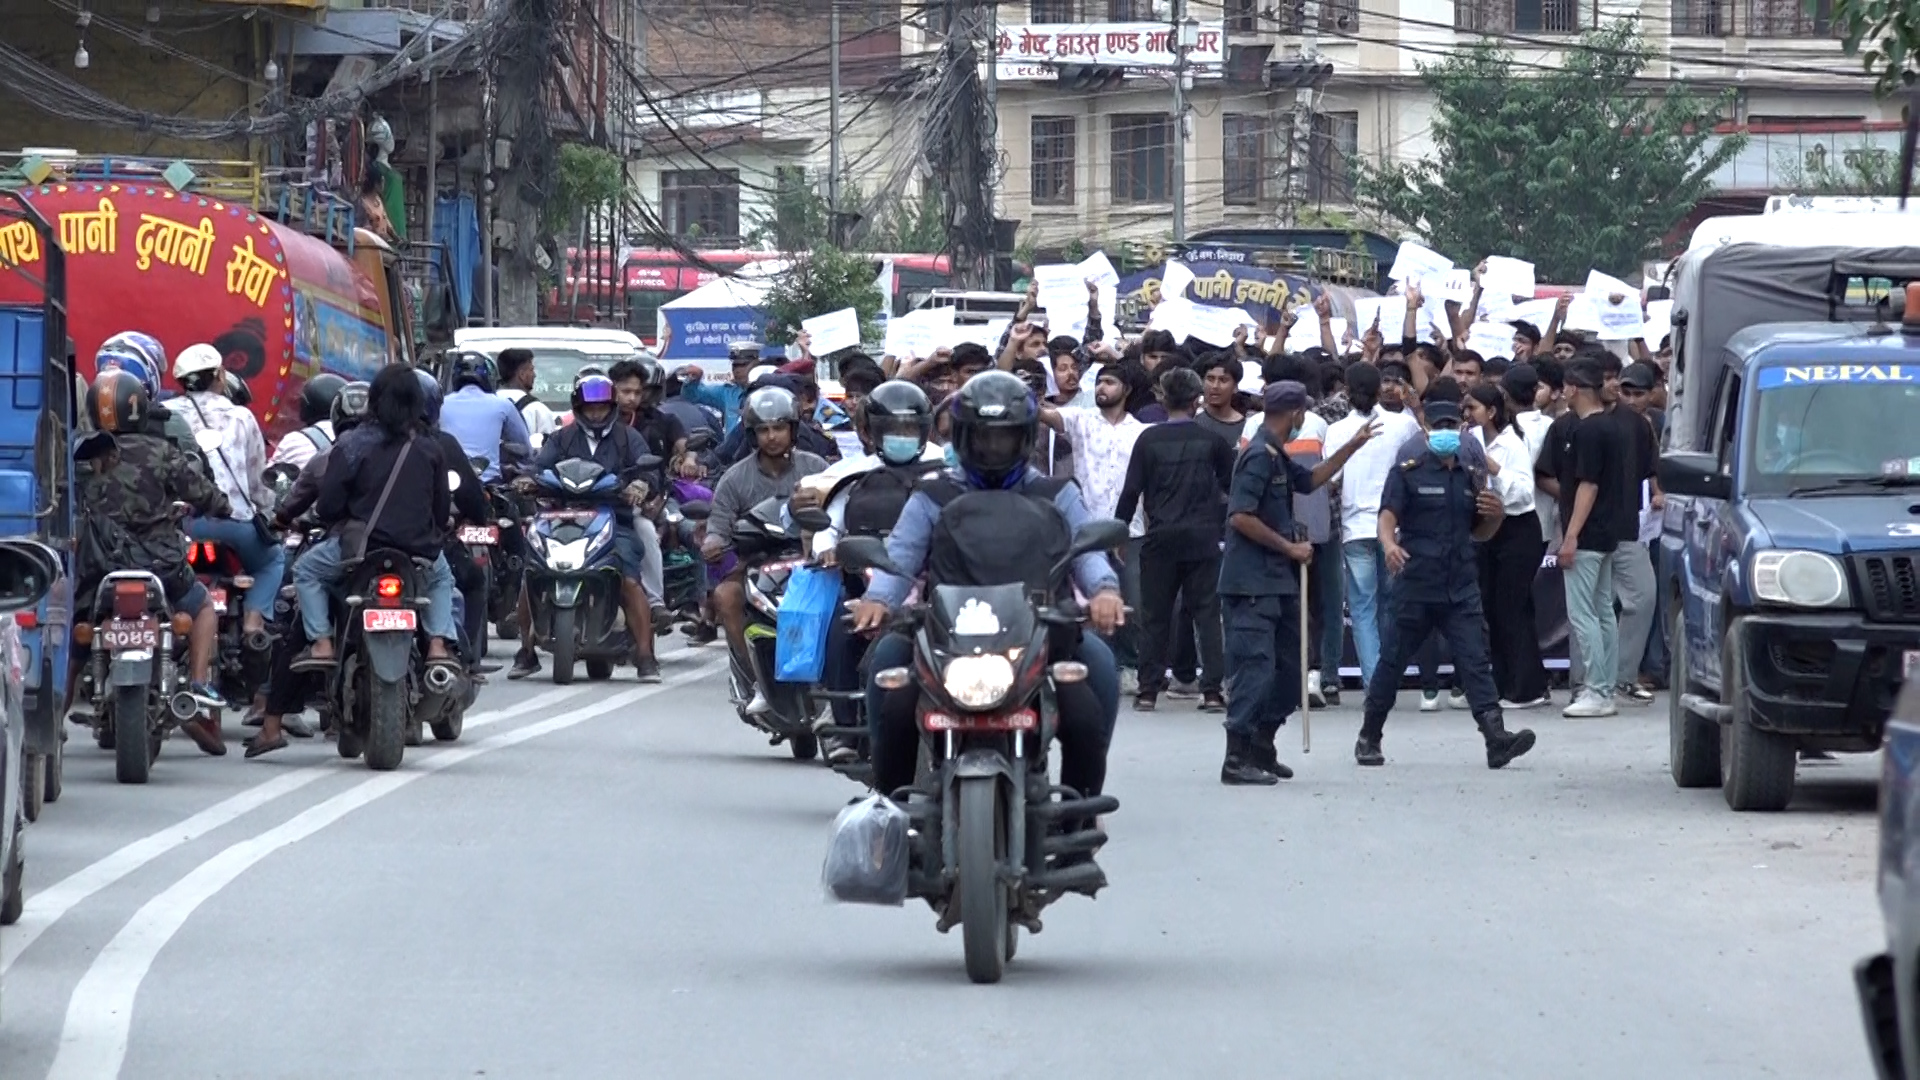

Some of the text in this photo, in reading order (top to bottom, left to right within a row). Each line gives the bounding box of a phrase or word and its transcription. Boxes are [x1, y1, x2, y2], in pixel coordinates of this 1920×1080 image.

[58, 197, 118, 254] पानी
[226, 235, 278, 308] सेवा
[1193, 269, 1235, 300] पानी
[1783, 364, 1913, 382] NEPAL
[128, 394, 140, 421] 1
